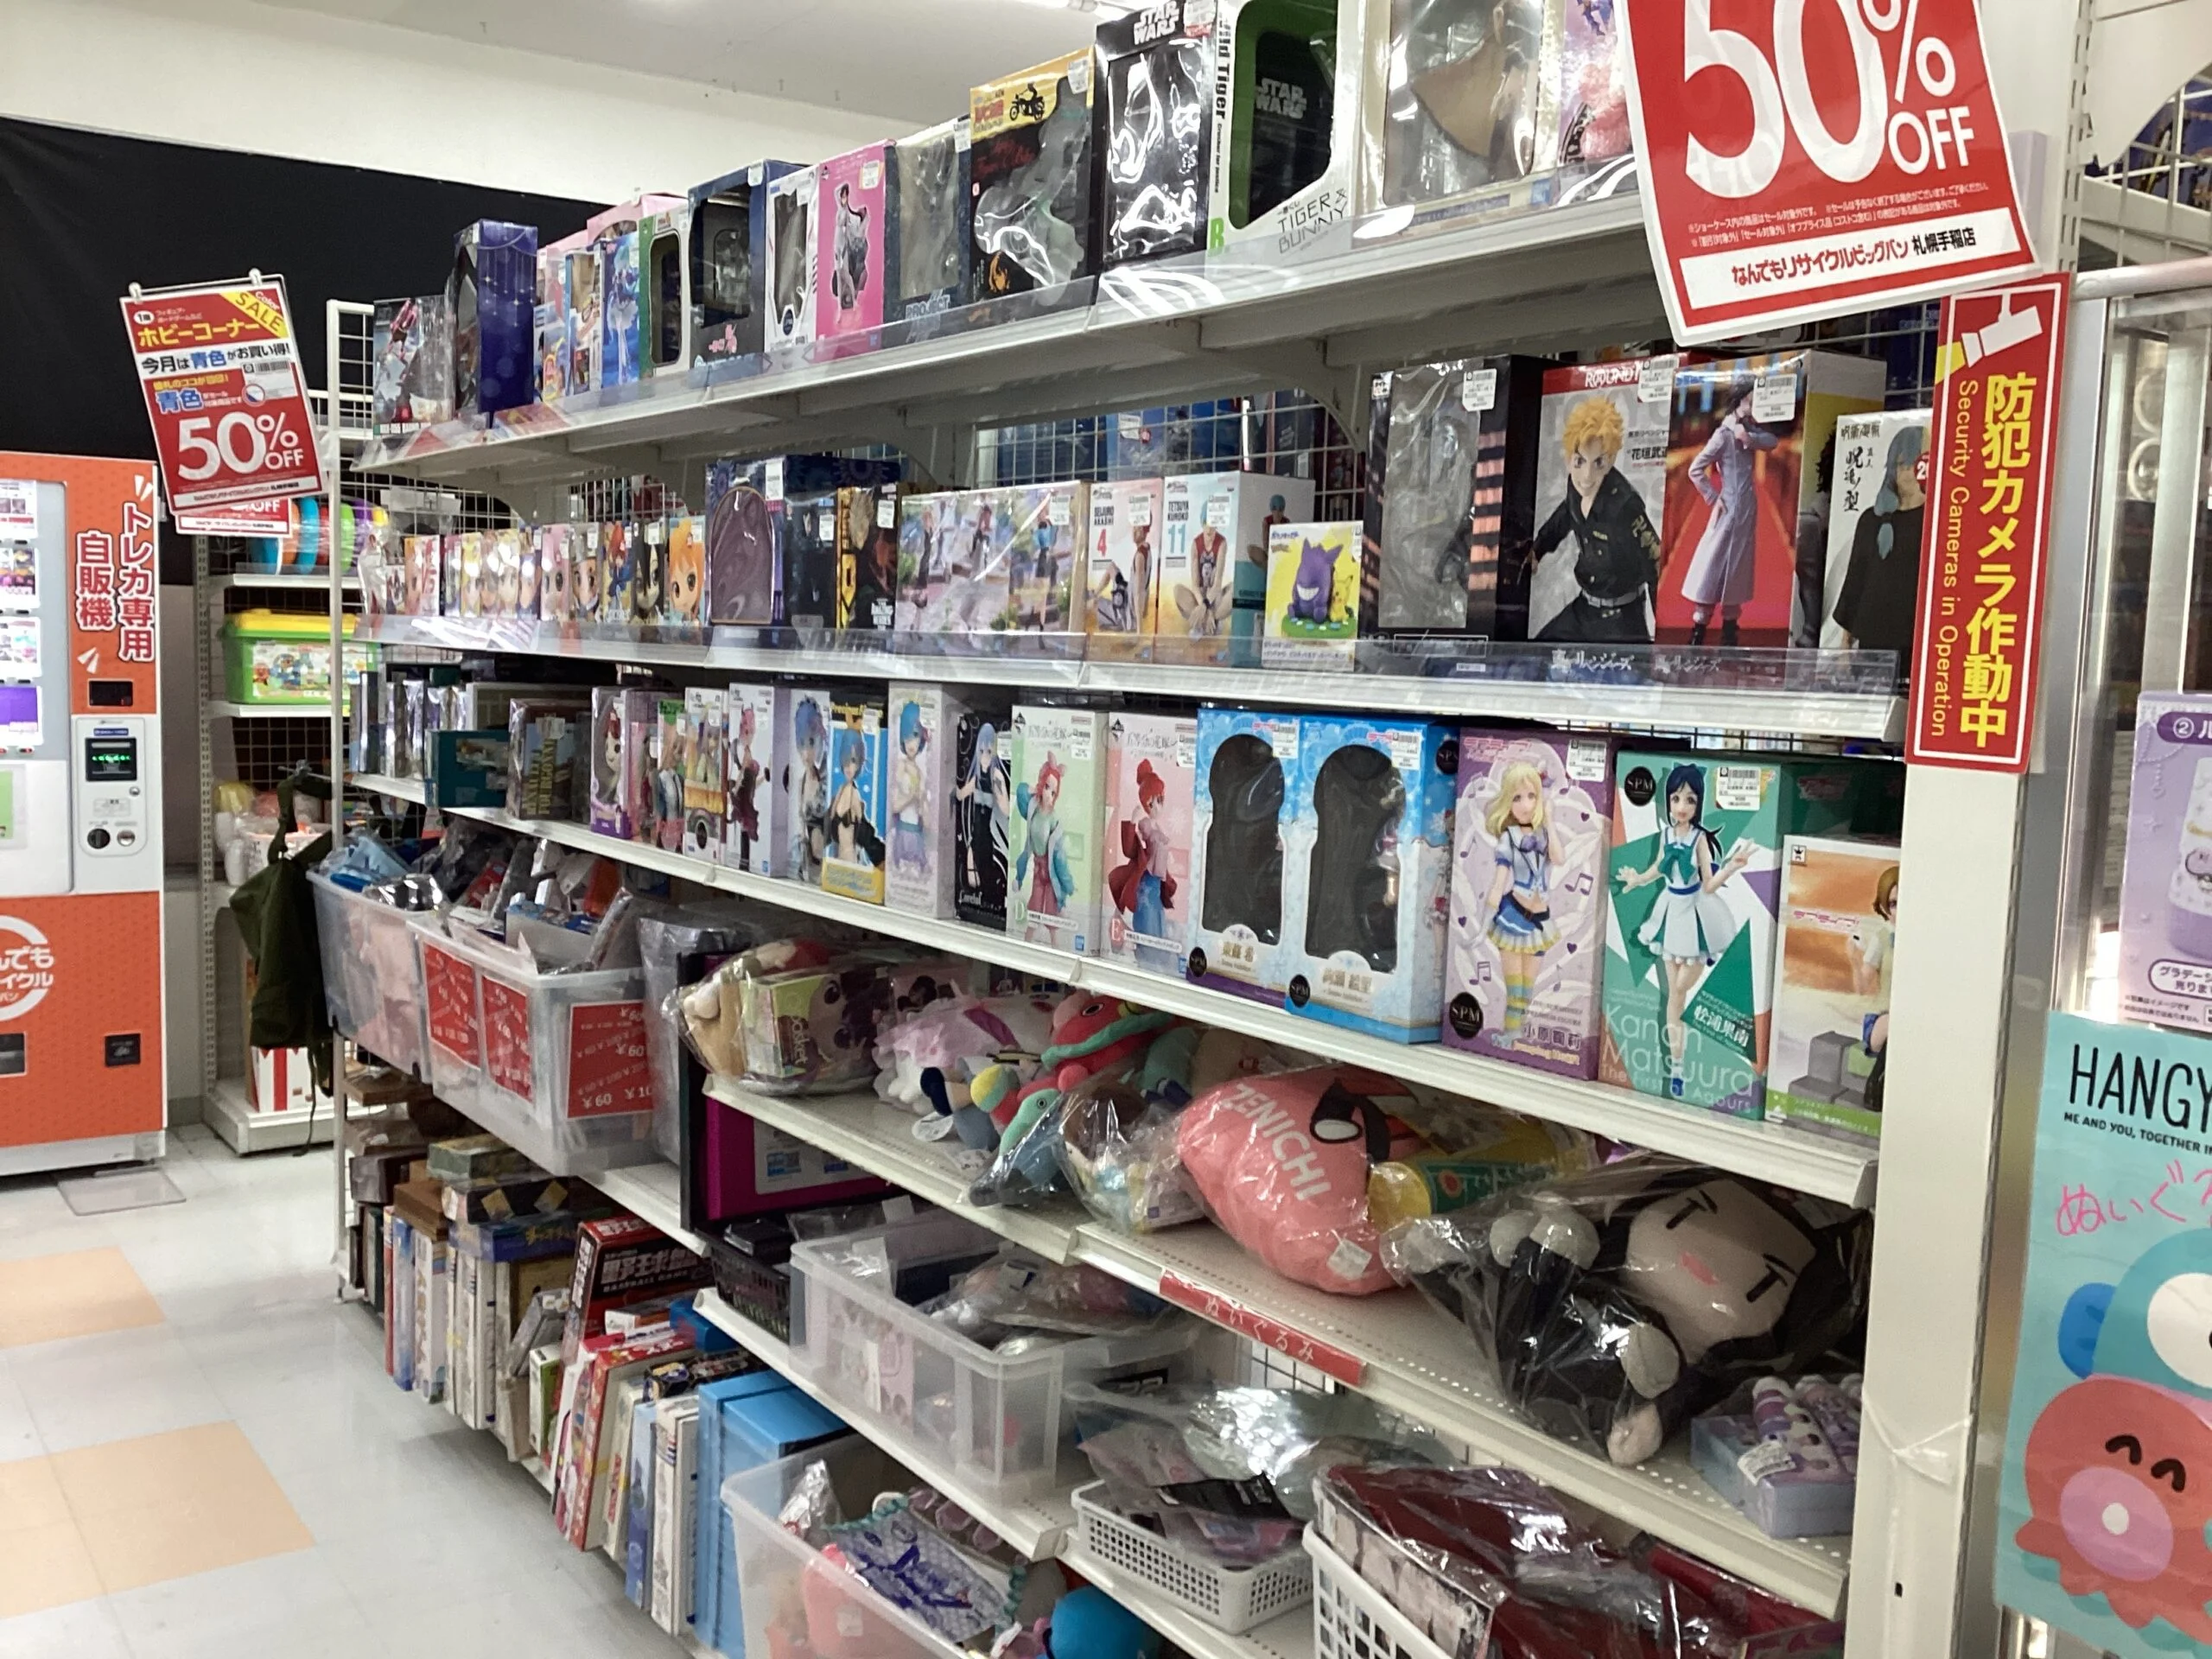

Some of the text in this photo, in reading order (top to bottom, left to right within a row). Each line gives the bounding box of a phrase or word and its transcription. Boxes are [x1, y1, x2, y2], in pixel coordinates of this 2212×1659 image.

[1134, 16, 1179, 45] WARS
[1135, 1, 1179, 27] STAR
[1216, 64, 1230, 119] Tiger
[1255, 78, 1306, 101] STAR
[1255, 95, 1307, 119] WARS
[1888, 106, 1974, 175] OFF
[1277, 193, 1331, 233] TIGER
[1279, 200, 1348, 254] BUNNY
[1732, 227, 1976, 286] なんでもリサイクルビッグバン 札幌手稲店
[138, 318, 259, 346] ホビーコーナー
[236, 292, 283, 332] SALE
[178, 411, 298, 480] 50%
[264, 448, 304, 469] OFF
[1097, 529, 1107, 556] 4
[1167, 524, 1186, 554] 11
[1931, 379, 1979, 737] Security Cameras in Operation
[1961, 372, 2037, 748] 防犯カメラ作動中
[78, 532, 114, 630] 自販機
[121, 503, 154, 662] トレカ専用
[1627, 779, 1654, 791] SPM
[1112, 918, 1122, 941] E
[1452, 1005, 1481, 1023] SPM
[1605, 1003, 1702, 1053] Kanan
[1225, 1084, 1332, 1201] ZENICHI
[2064, 1112, 2078, 1123] ME
[2082, 1116, 2107, 1130] AND
[2109, 1122, 2136, 1139] YOU,
[2140, 1129, 2201, 1153] TOGETHER
[604, 1269, 688, 1293] BASEBALL GAME
[1205, 1296, 1314, 1363] ぬいぐるみ
